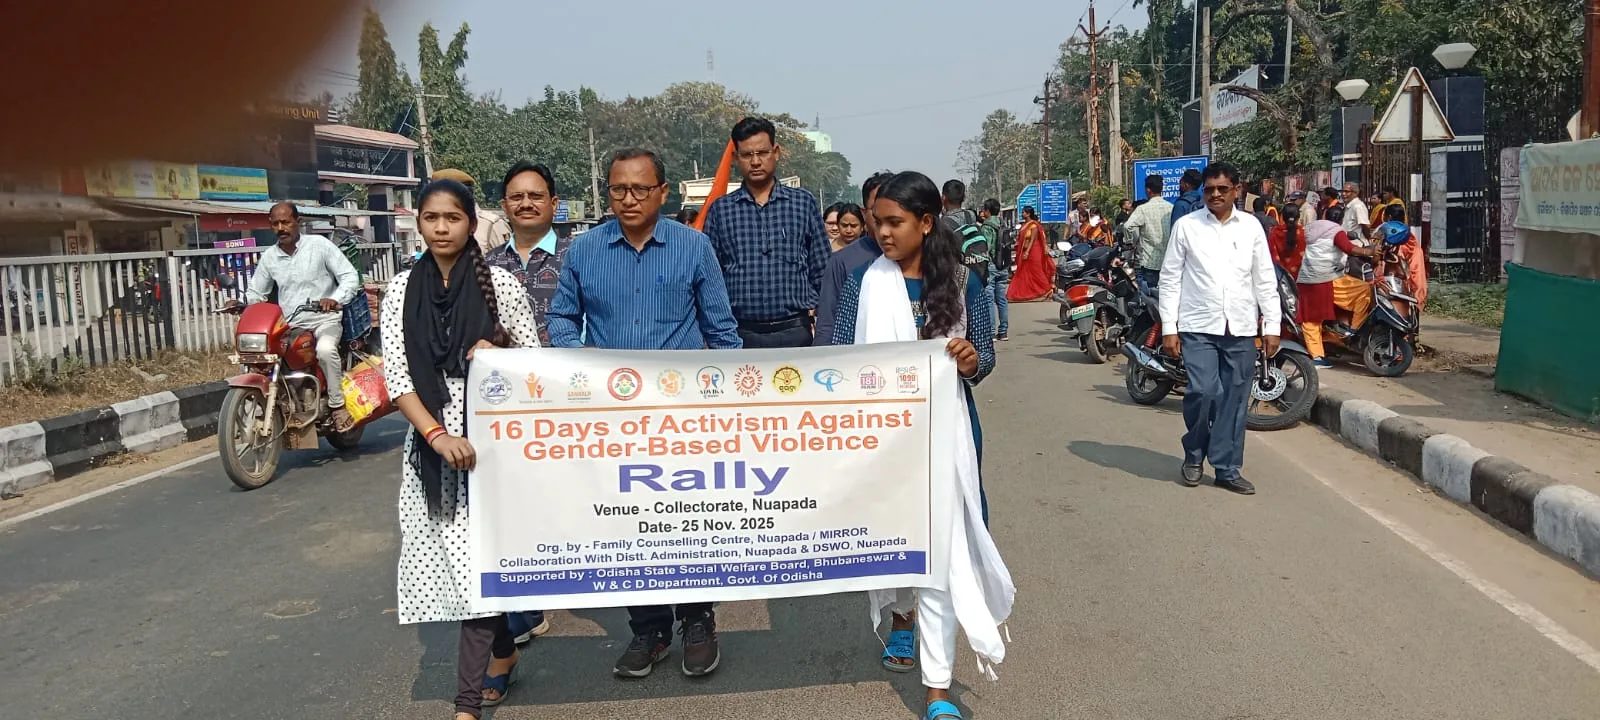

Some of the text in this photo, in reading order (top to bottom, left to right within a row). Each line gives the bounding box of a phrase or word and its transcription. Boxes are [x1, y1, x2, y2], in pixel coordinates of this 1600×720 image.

[301, 107, 320, 119] Unit
[861, 376, 876, 386] 181
[490, 410, 912, 442] 16 Days of Activism Against
[523, 431, 878, 460] Gender-Based Violence
[618, 462, 790, 495] Rally
[593, 503, 640, 517] Venue
[653, 499, 748, 515] Collectorate,
[752, 497, 817, 513] Nuapada
[638, 517, 775, 534] Date- 25 Nov. 2025
[499, 536, 907, 568] Collaboration With Distt. Administration, Nuapada & DSWO, Nuapada
[536, 543, 563, 555] Org.
[566, 541, 582, 554] by
[593, 539, 633, 551] Family
[636, 536, 708, 548] Counselling
[711, 535, 754, 547] Centre,
[757, 533, 809, 545] Nuapada
[819, 527, 869, 539] MIRROR
[499, 570, 566, 583] Supported
[569, 569, 585, 581] by
[596, 566, 641, 578] Odisha
[644, 565, 676, 576] State
[679, 563, 716, 575] Social
[721, 562, 767, 573] Welfare
[770, 559, 810, 571] Board,
[814, 552, 895, 568] Bhubaneswar
[898, 551, 907, 561] &
[593, 571, 823, 591] W & C D Department, Govt. Of Odisha
